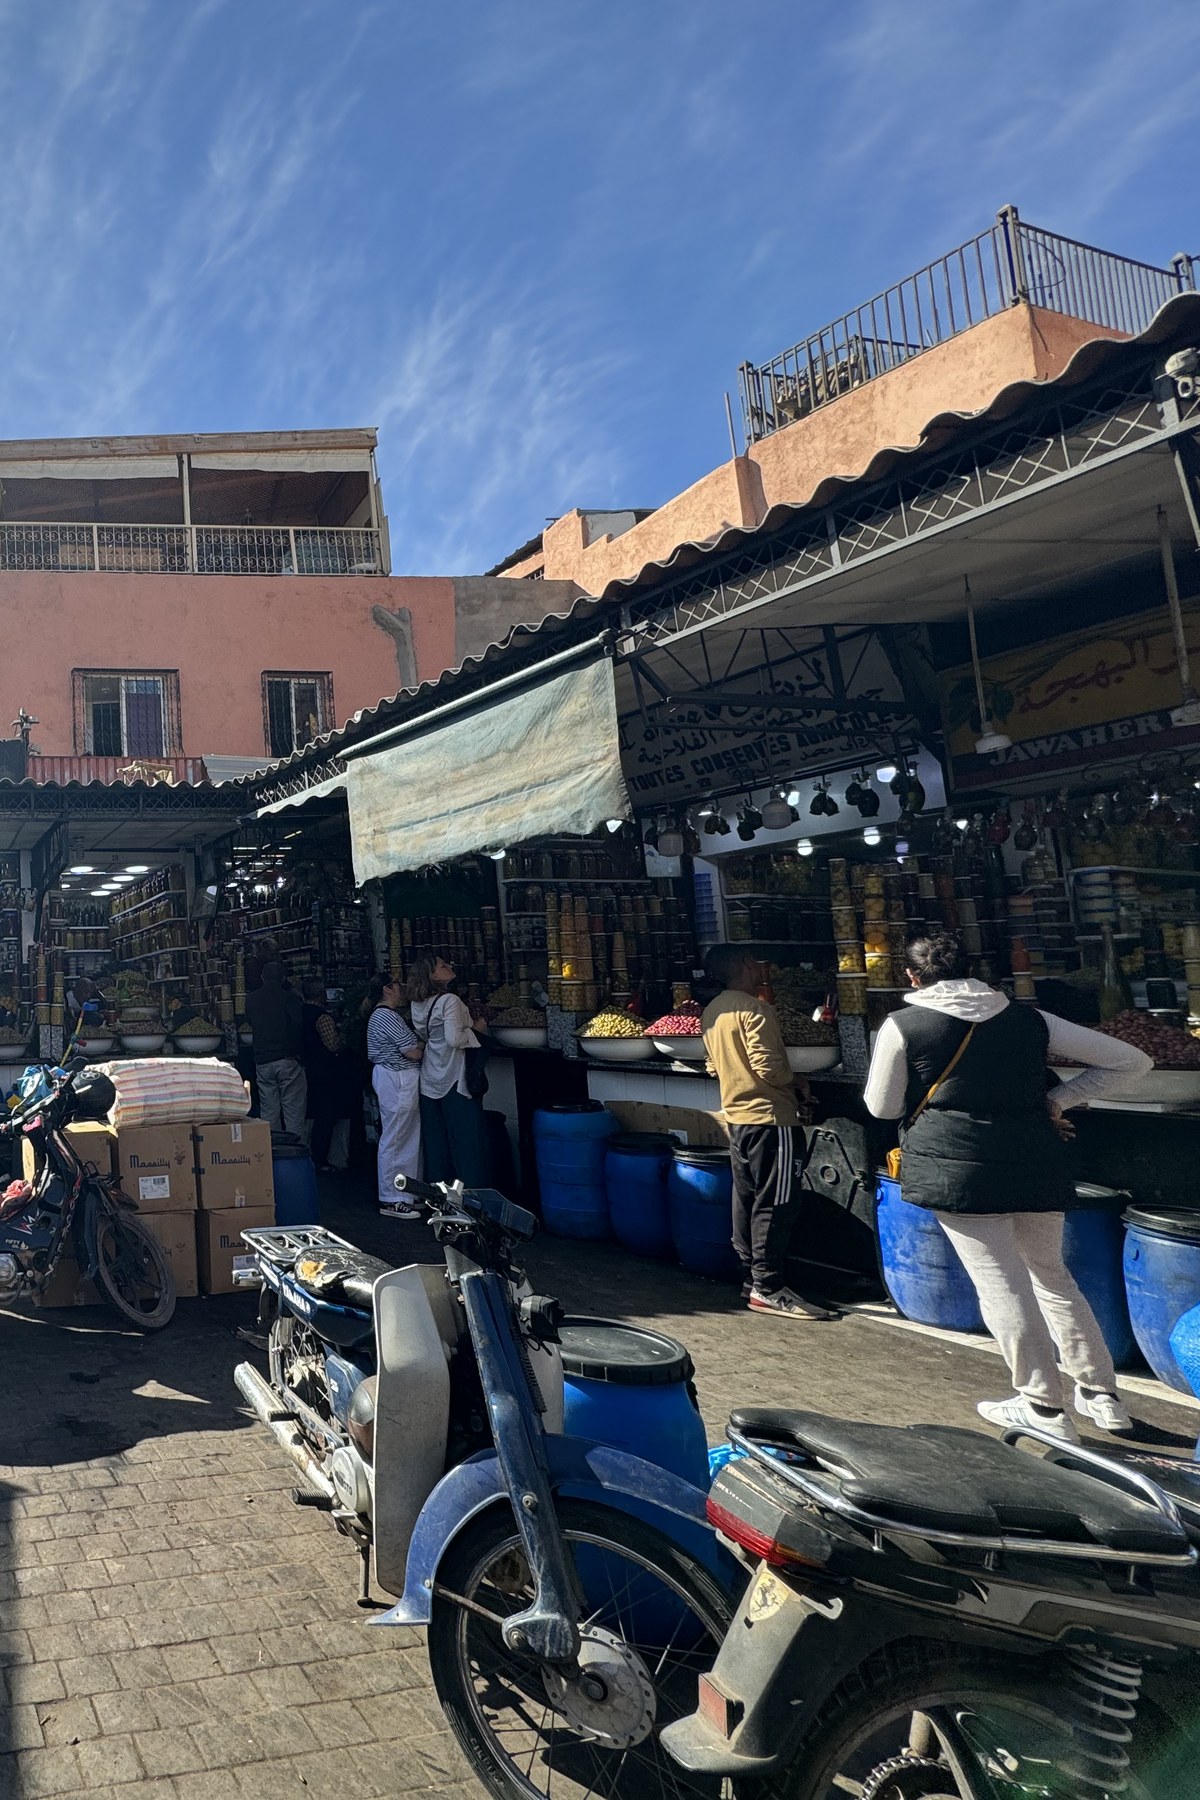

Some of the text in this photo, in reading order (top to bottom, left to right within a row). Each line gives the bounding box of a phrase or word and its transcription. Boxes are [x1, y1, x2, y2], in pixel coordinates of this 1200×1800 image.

[988, 714, 1163, 767] JAWAHER
[628, 765, 685, 792] TOUTES
[690, 735, 791, 777] CONSERVES
[130, 1154, 171, 1169] Massilly
[211, 1151, 251, 1166] Massilly
